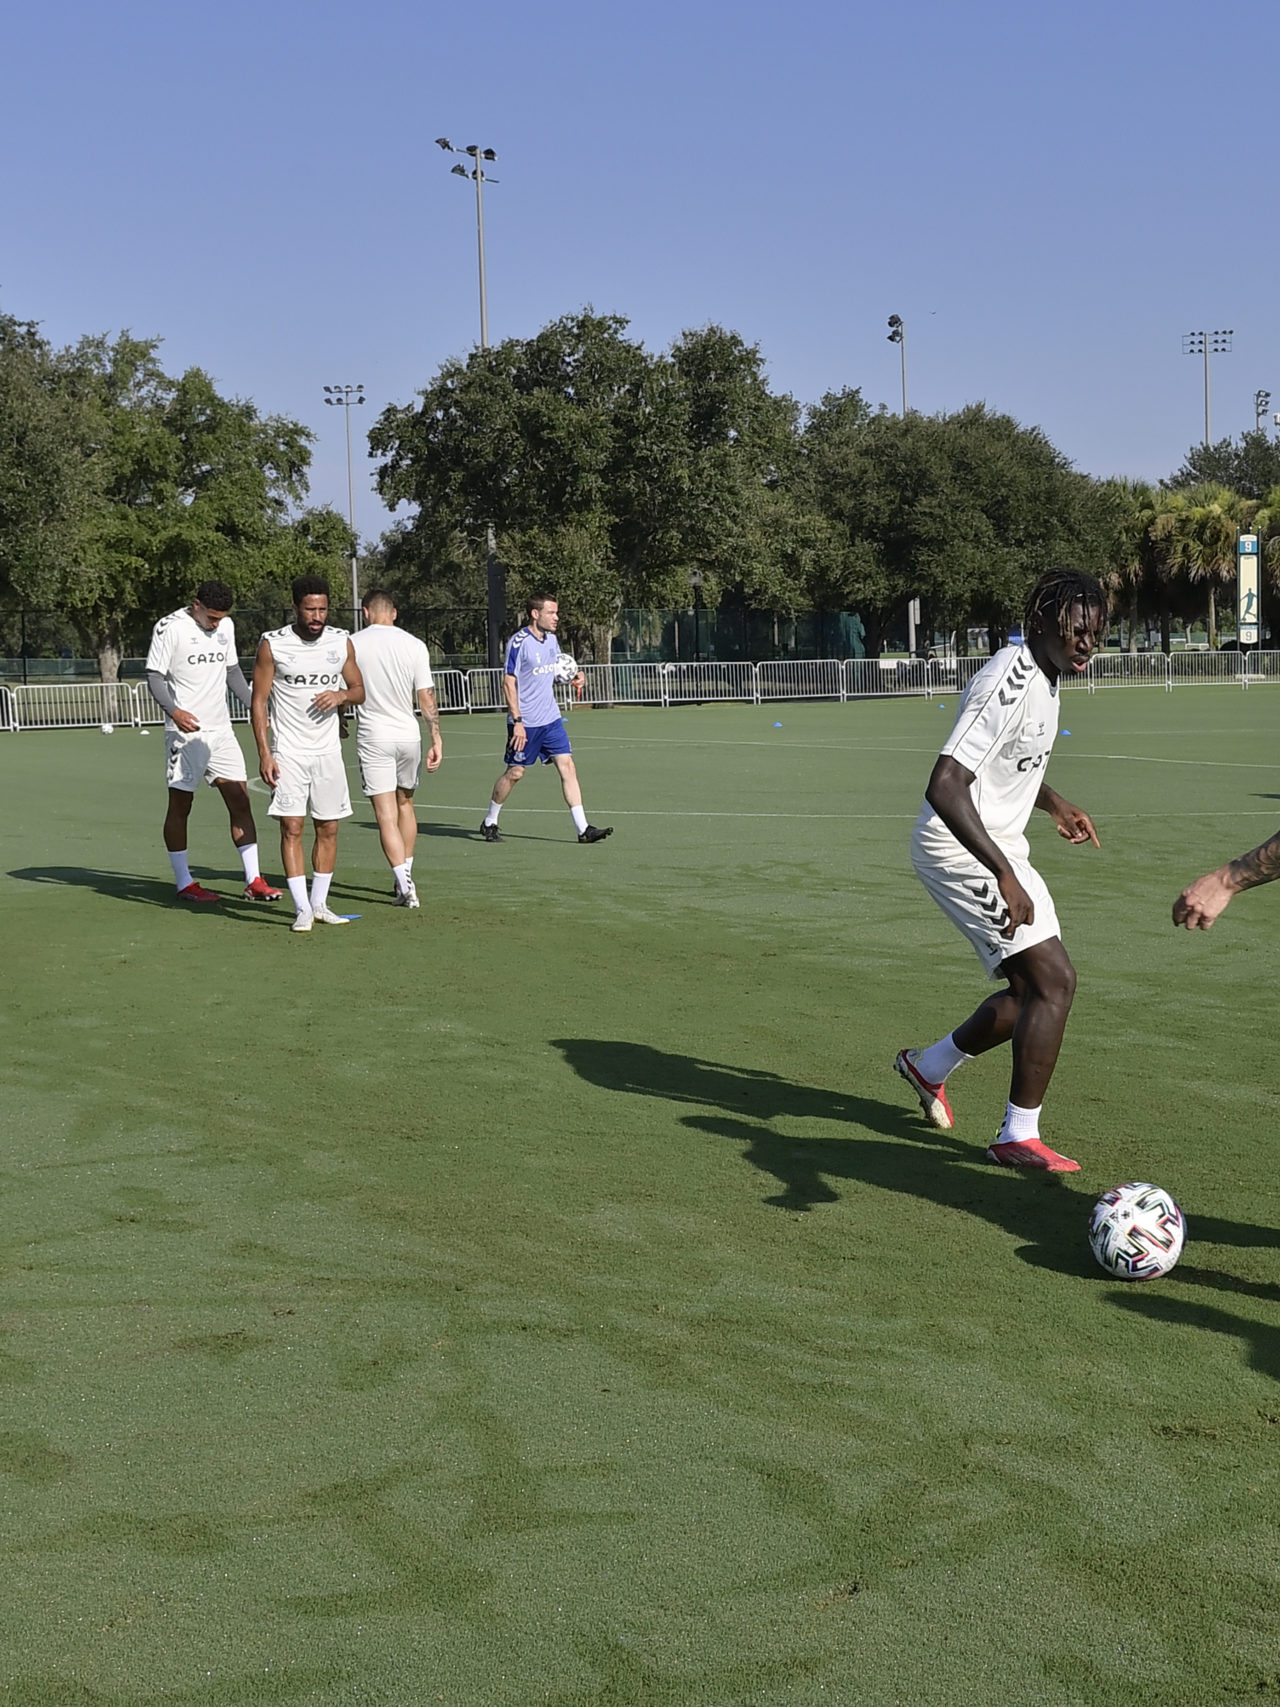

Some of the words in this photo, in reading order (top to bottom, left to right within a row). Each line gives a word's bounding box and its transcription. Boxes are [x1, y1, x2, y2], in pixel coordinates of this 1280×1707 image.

[1244, 541, 1252, 552] 9
[1245, 631, 1252, 641] 9
[187, 652, 227, 665] CAZO
[283, 674, 338, 686] CAZOO
